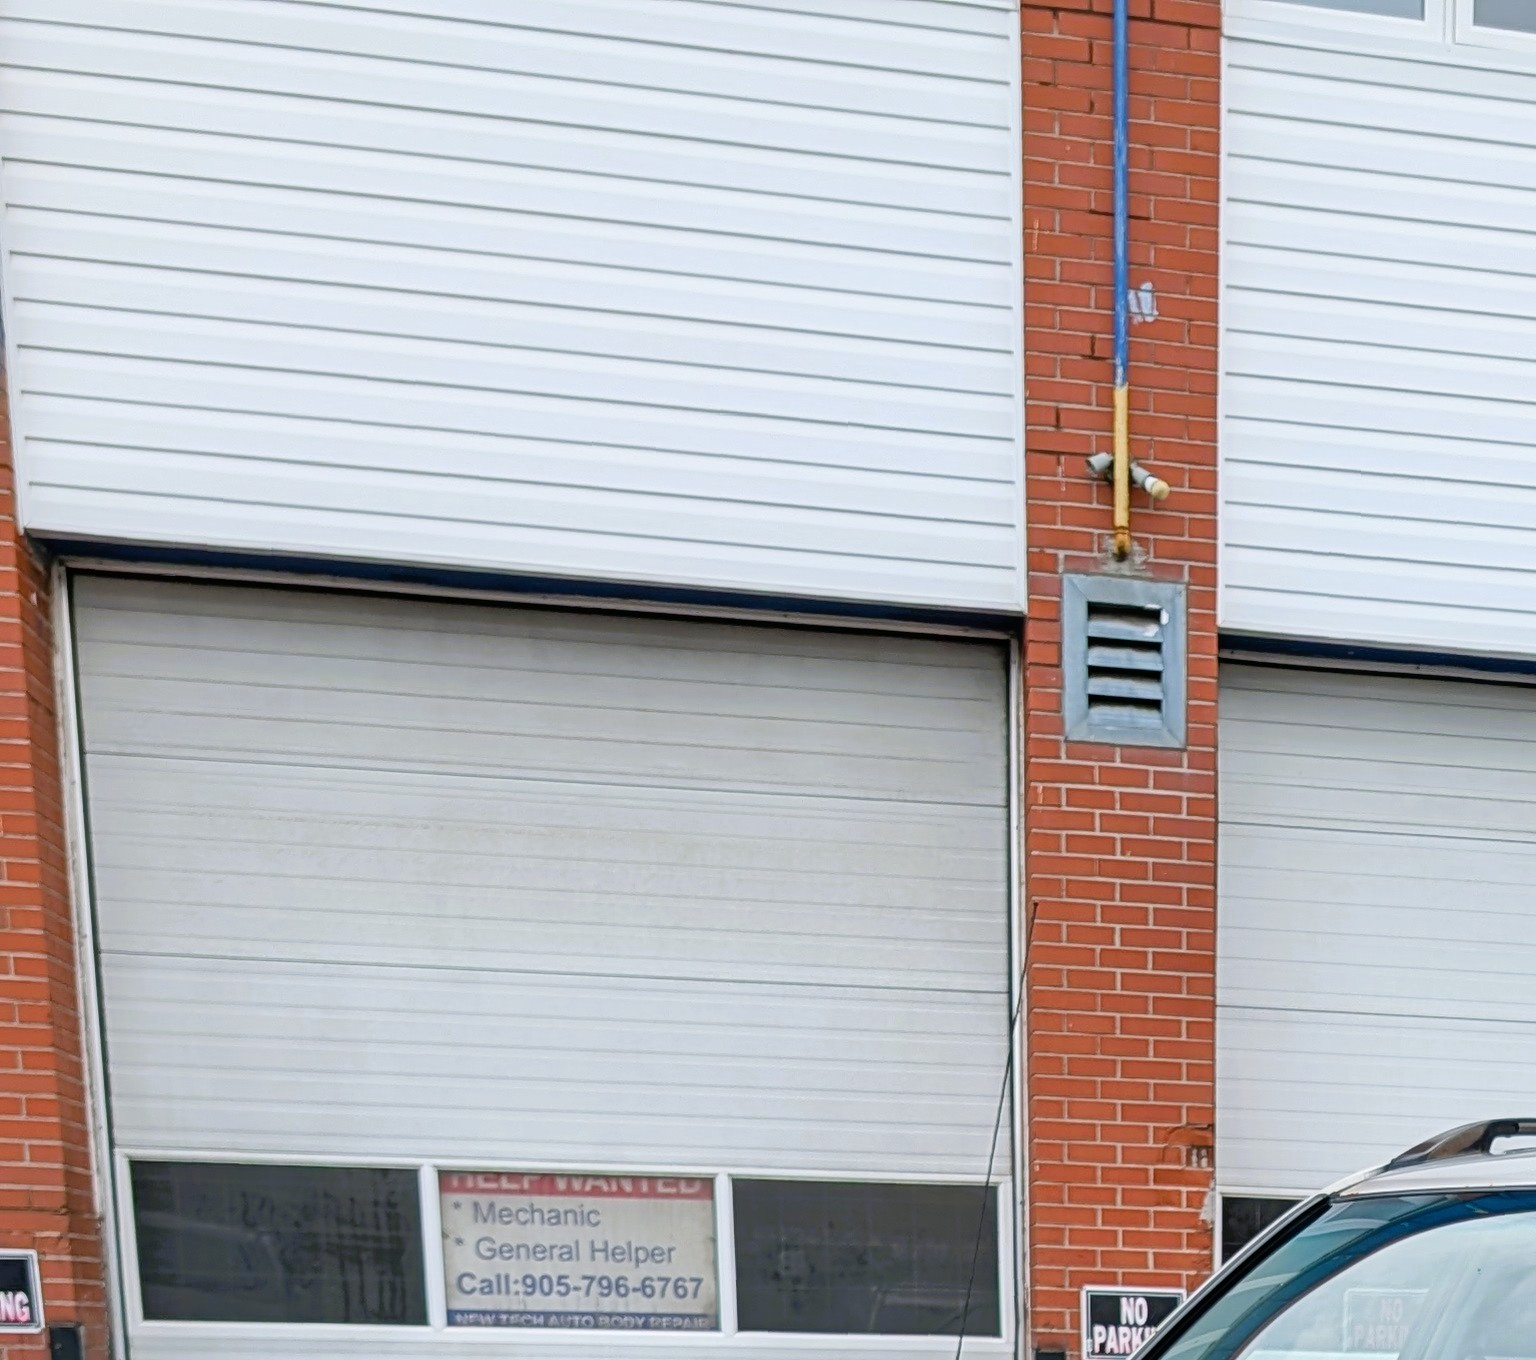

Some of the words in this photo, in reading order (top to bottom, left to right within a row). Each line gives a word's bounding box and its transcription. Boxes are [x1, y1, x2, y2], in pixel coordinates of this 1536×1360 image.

[473, 1201, 601, 1227] Mechanic
[475, 1236, 580, 1262] General
[590, 1239, 676, 1268] Helper
[456, 1272, 704, 1300] Call:905-796-6767
[547, 1314, 595, 1328] AUTO
[598, 1315, 645, 1328] BODY
[1120, 1296, 1148, 1325] NO
